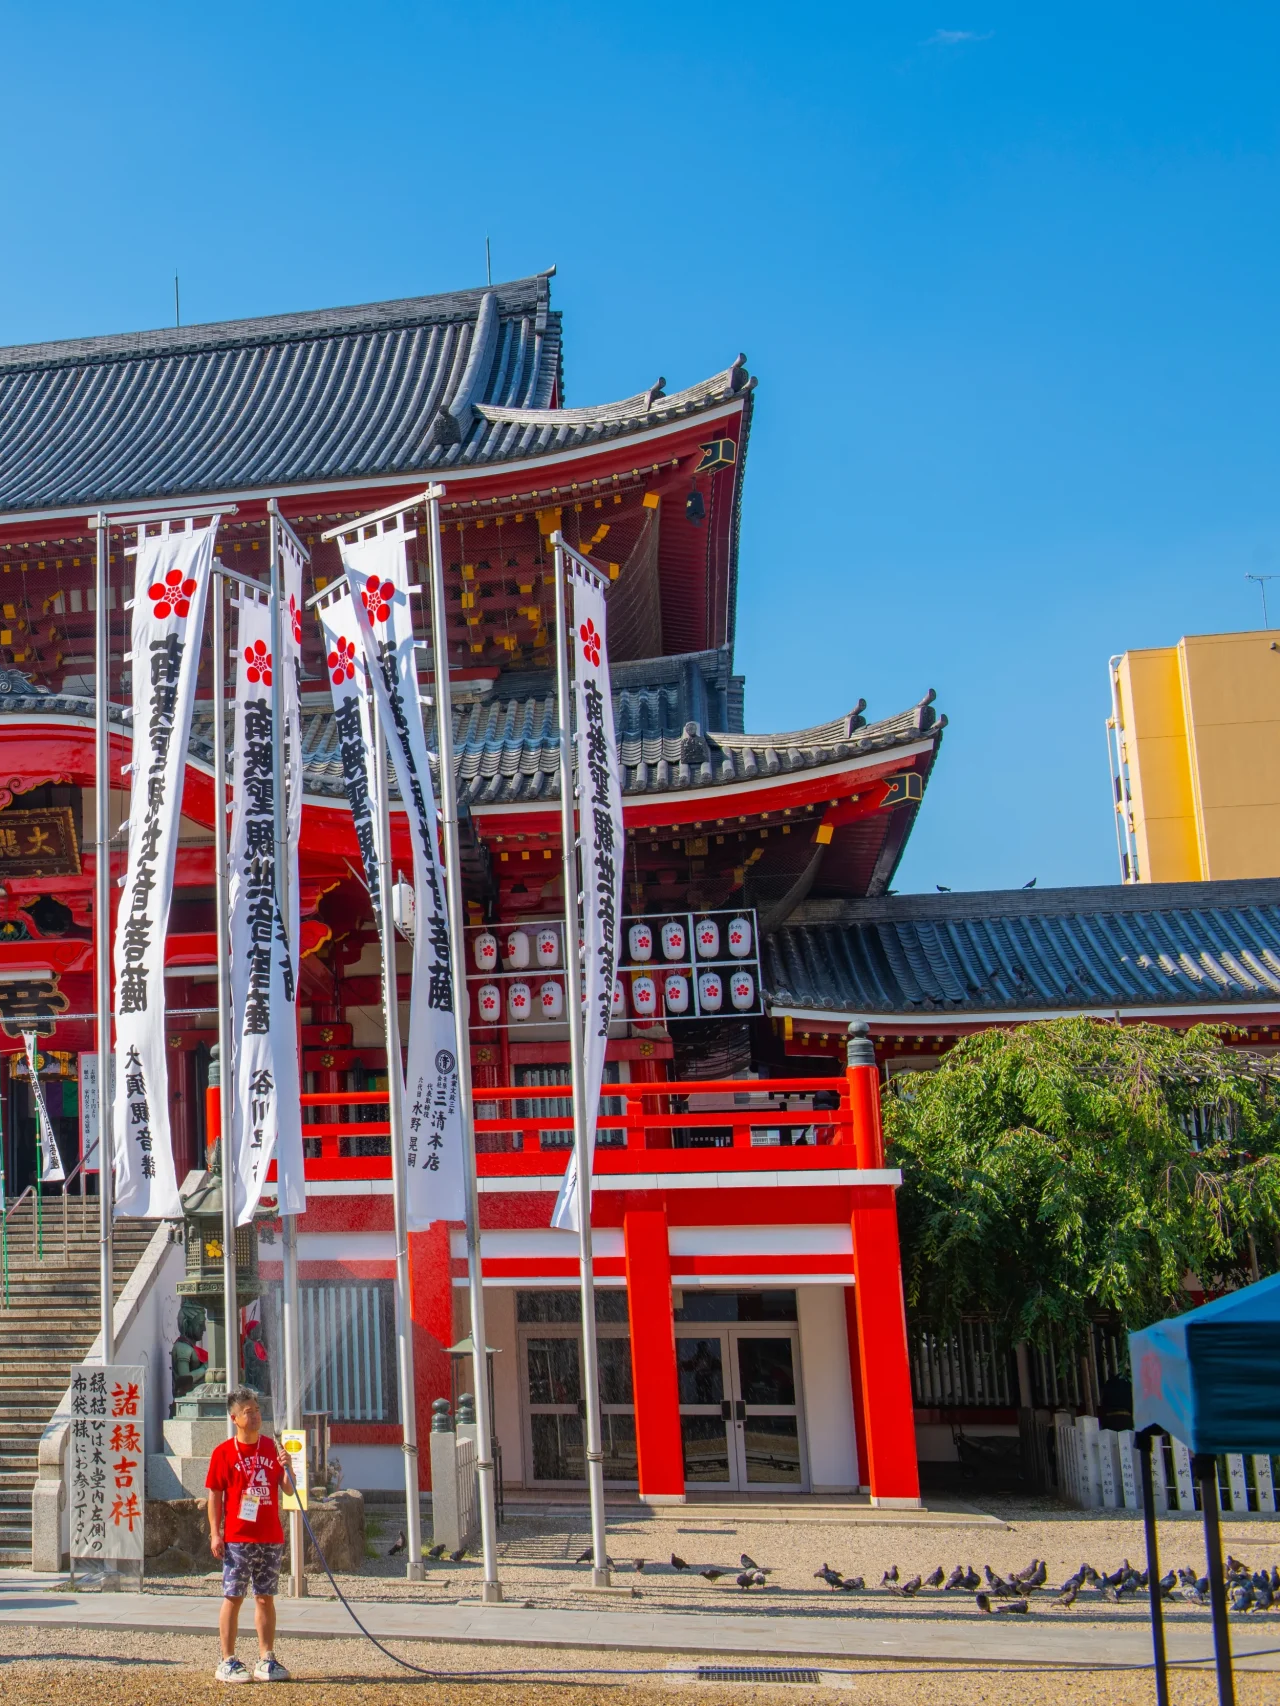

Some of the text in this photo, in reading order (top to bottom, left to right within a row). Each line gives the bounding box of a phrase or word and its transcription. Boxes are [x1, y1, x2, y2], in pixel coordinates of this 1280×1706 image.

[422, 1091, 447, 1171] 三清本店
[423, 1083, 433, 1118] 代表取締役
[72, 1372, 90, 1546] 布袋様にお参り下さい
[88, 1372, 107, 1552] 縁結びは本堂内左側の
[108, 1381, 142, 1533] 諸縁吉祥
